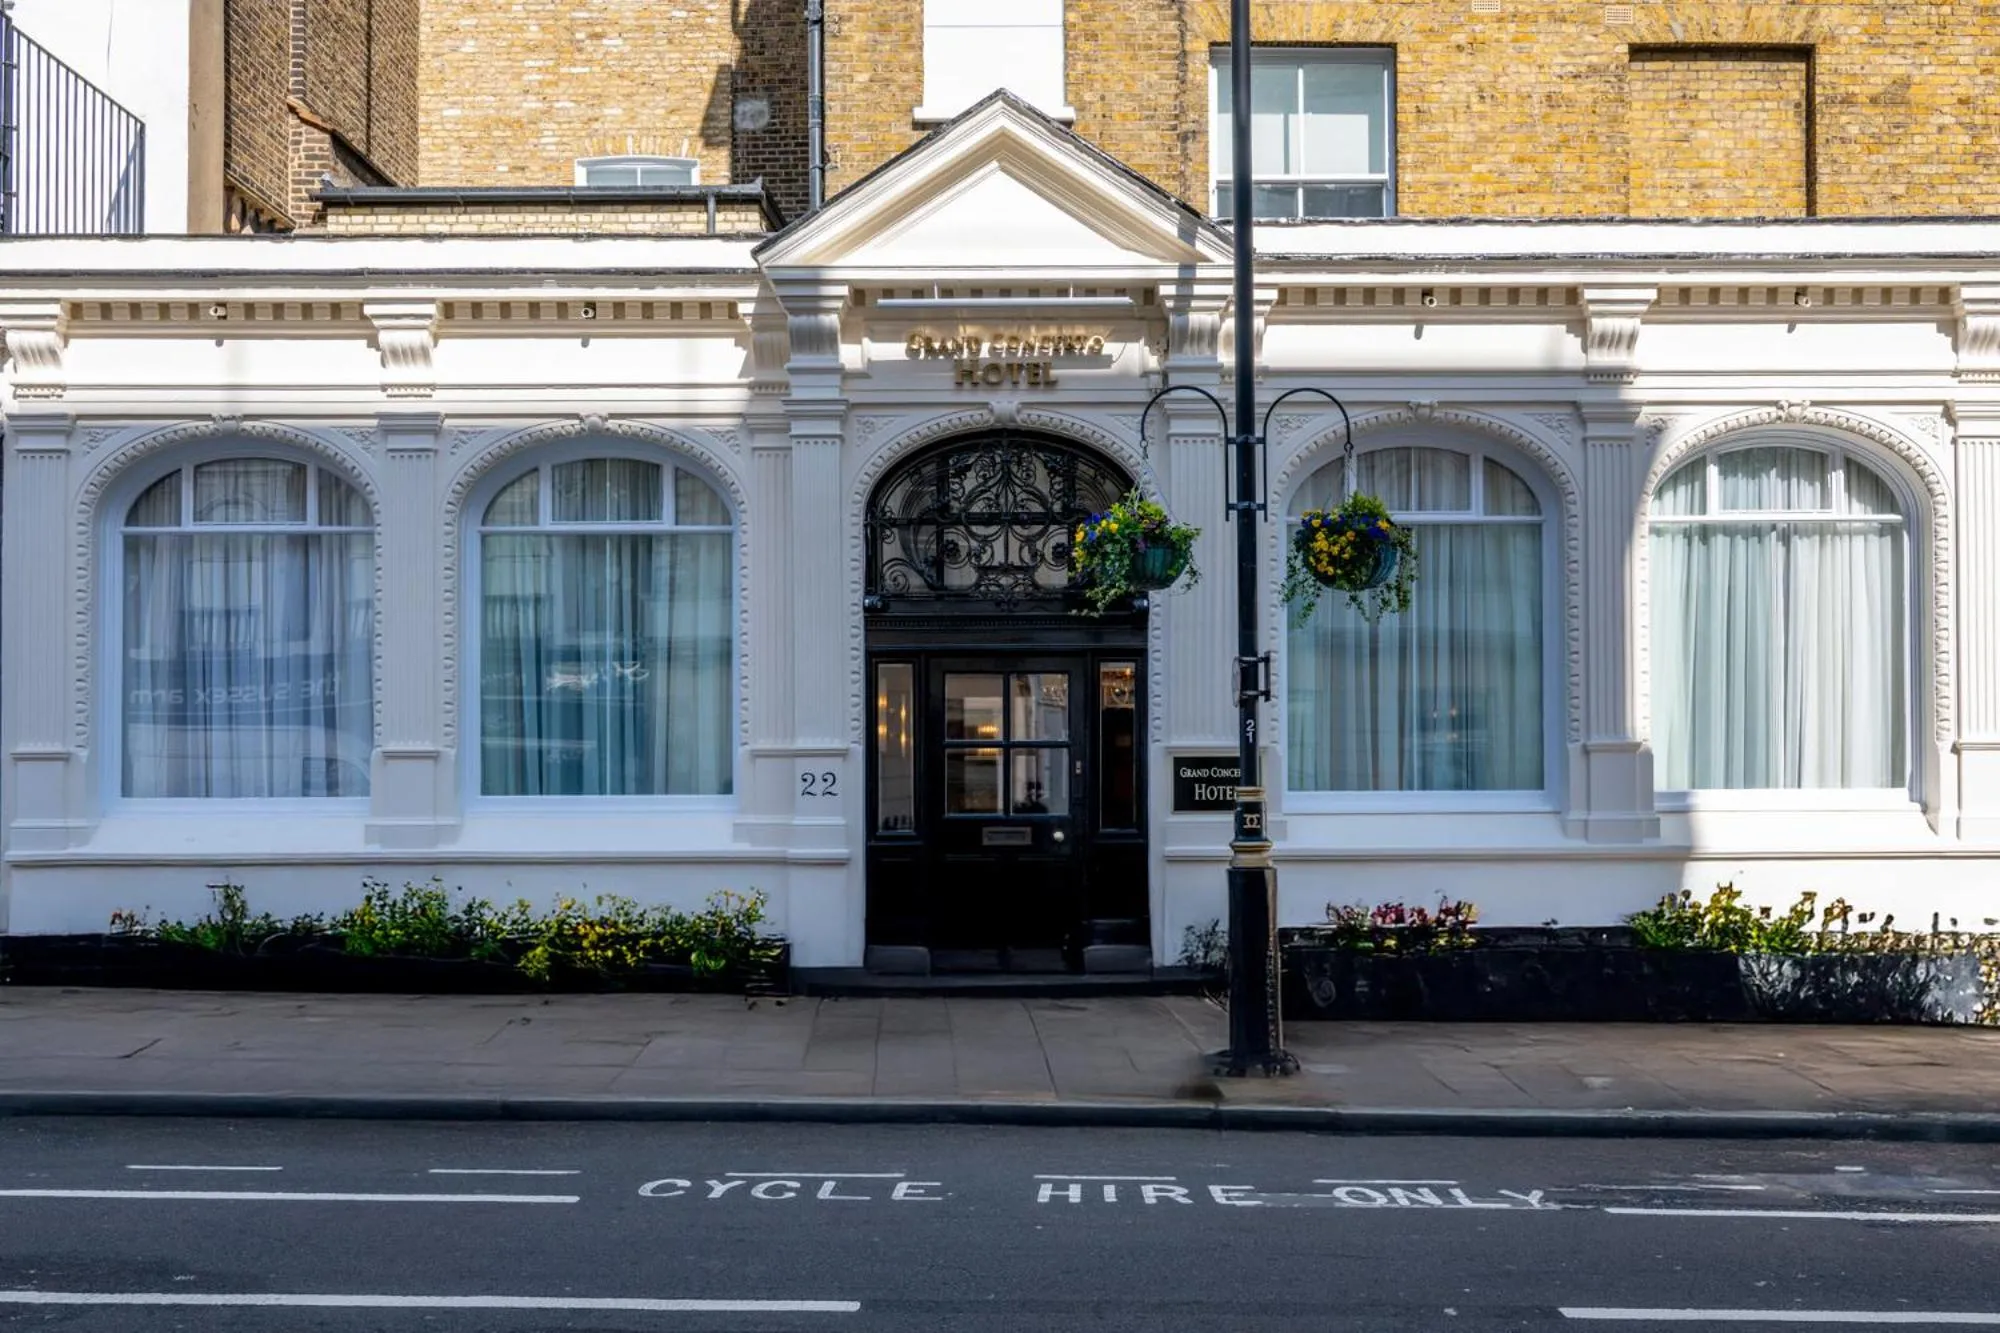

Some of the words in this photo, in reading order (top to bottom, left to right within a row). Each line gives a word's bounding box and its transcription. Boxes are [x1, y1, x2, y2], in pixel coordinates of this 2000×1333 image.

[953, 358, 1059, 387] HOTEL
[801, 772, 838, 797] 22
[1180, 767, 1209, 778] GRAND
[1210, 767, 1241, 778] CONCE
[638, 1178, 943, 1201] CYCLE
[1037, 1183, 1263, 1206] HIRE
[1332, 1186, 1544, 1208] ONLY
